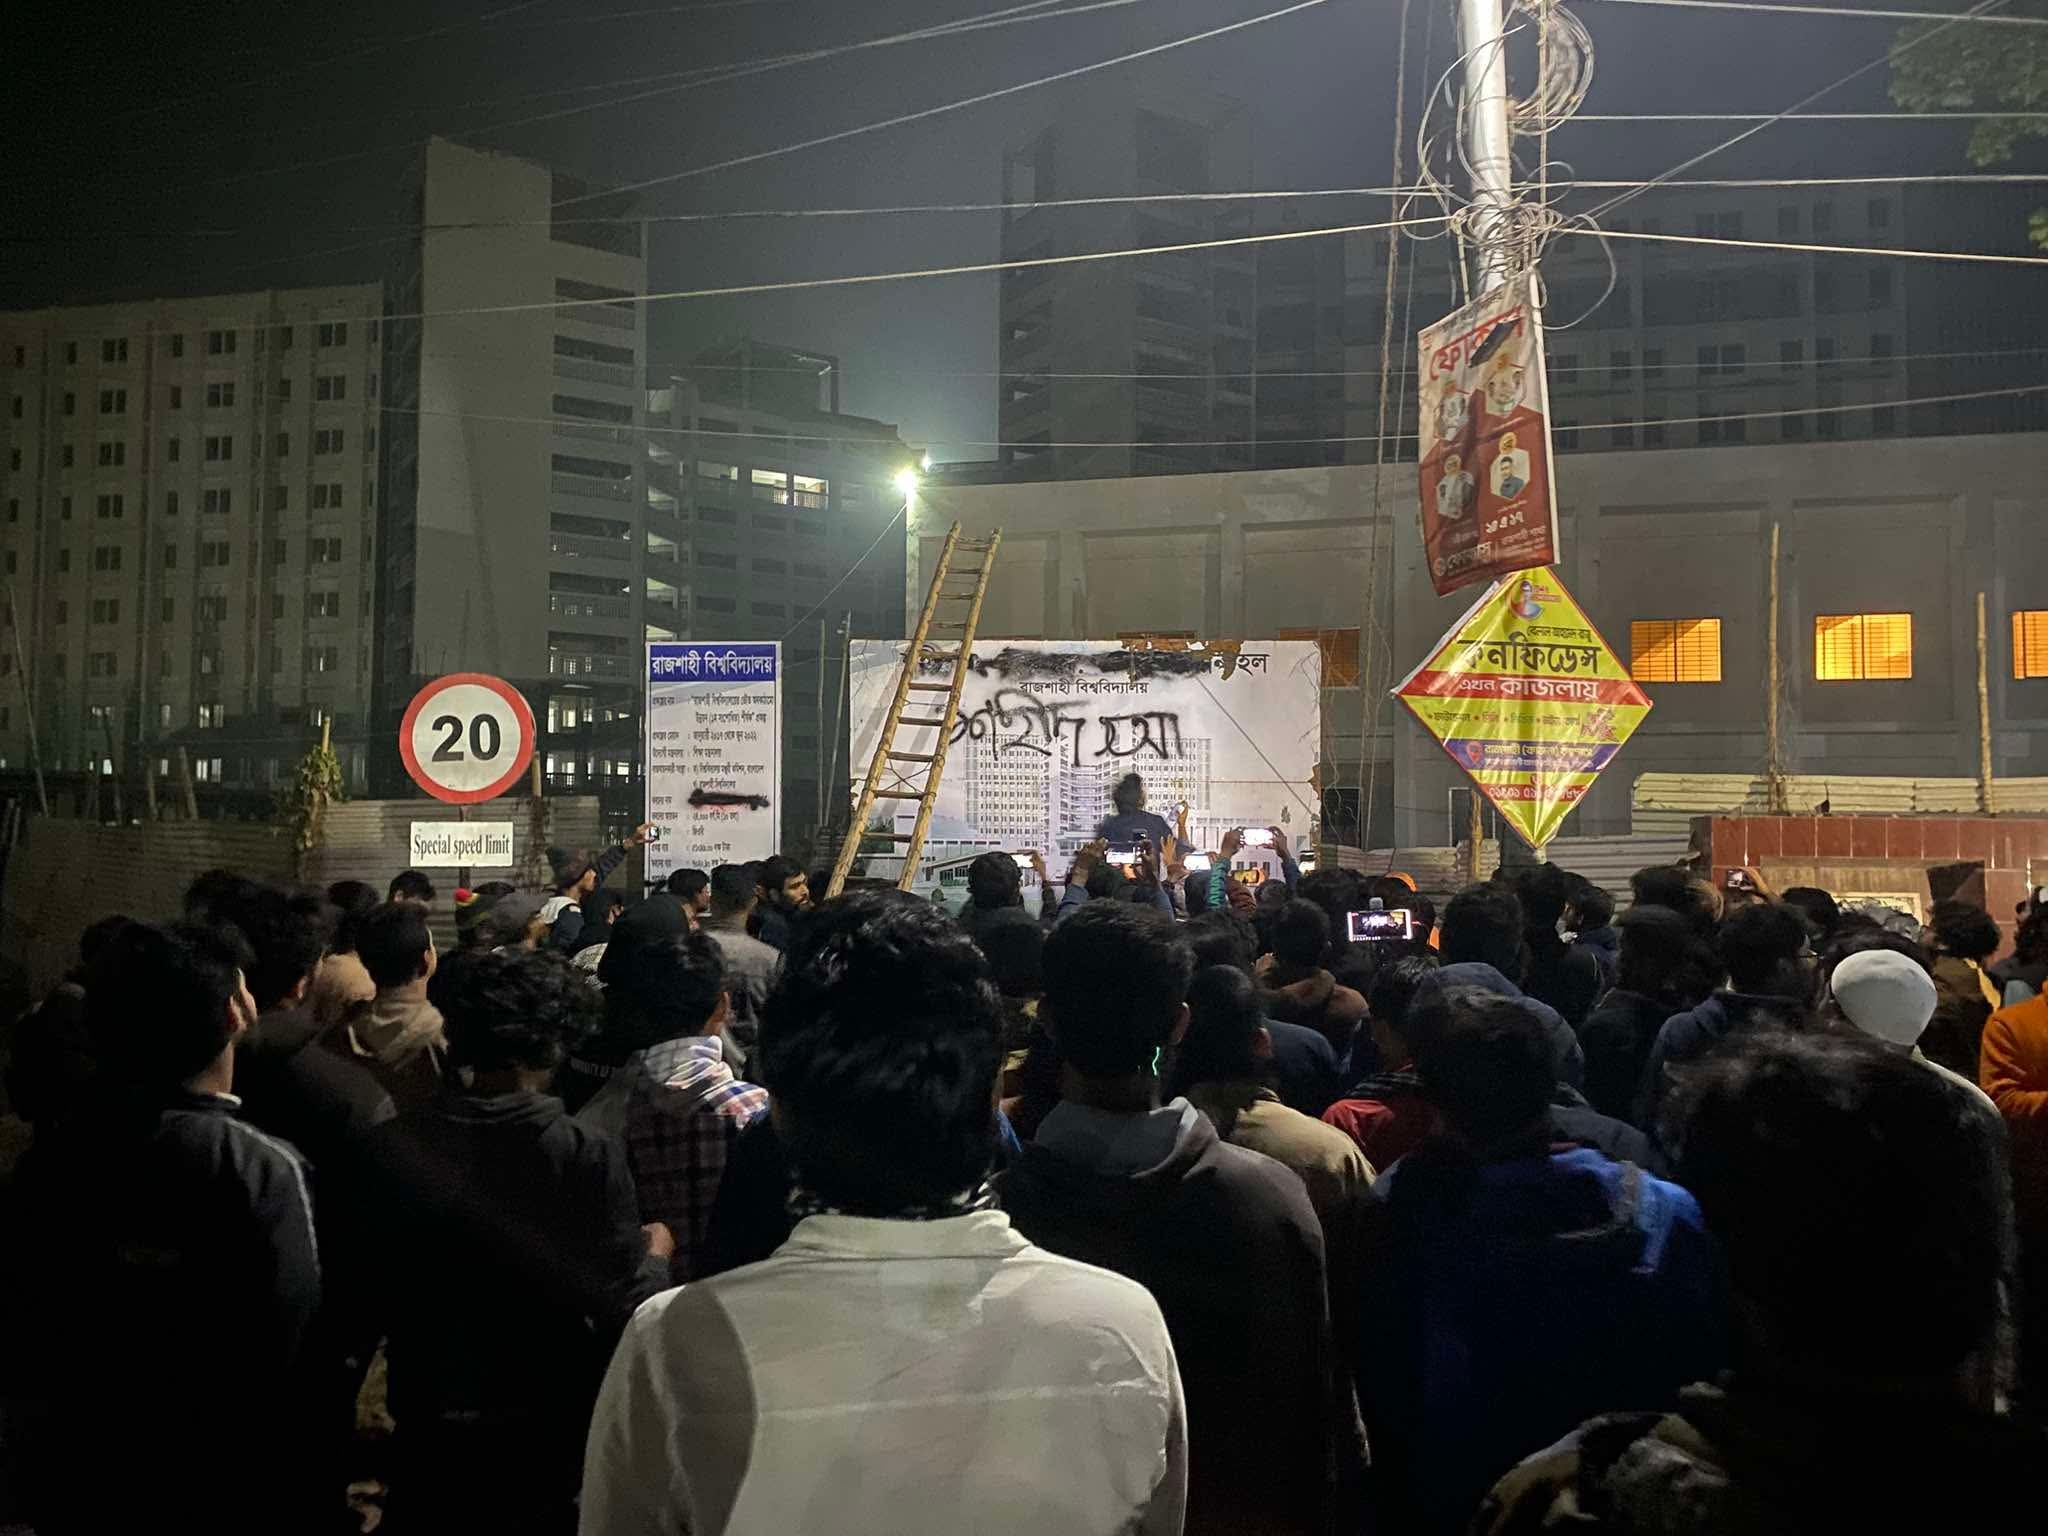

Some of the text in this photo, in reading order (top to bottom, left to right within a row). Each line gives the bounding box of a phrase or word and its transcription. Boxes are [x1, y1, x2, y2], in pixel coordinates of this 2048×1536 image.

[652, 650, 773, 677] রাজশাহী বিশ্ববিদ্যালয়
[1237, 653, 1270, 675] হল
[1019, 679, 1150, 696] রাজশাহী বিশ্ববিদ্যালয়
[1459, 678, 1600, 700] এখন কাজলায়
[432, 713, 501, 762] 20
[413, 834, 510, 860] Special speed limit
